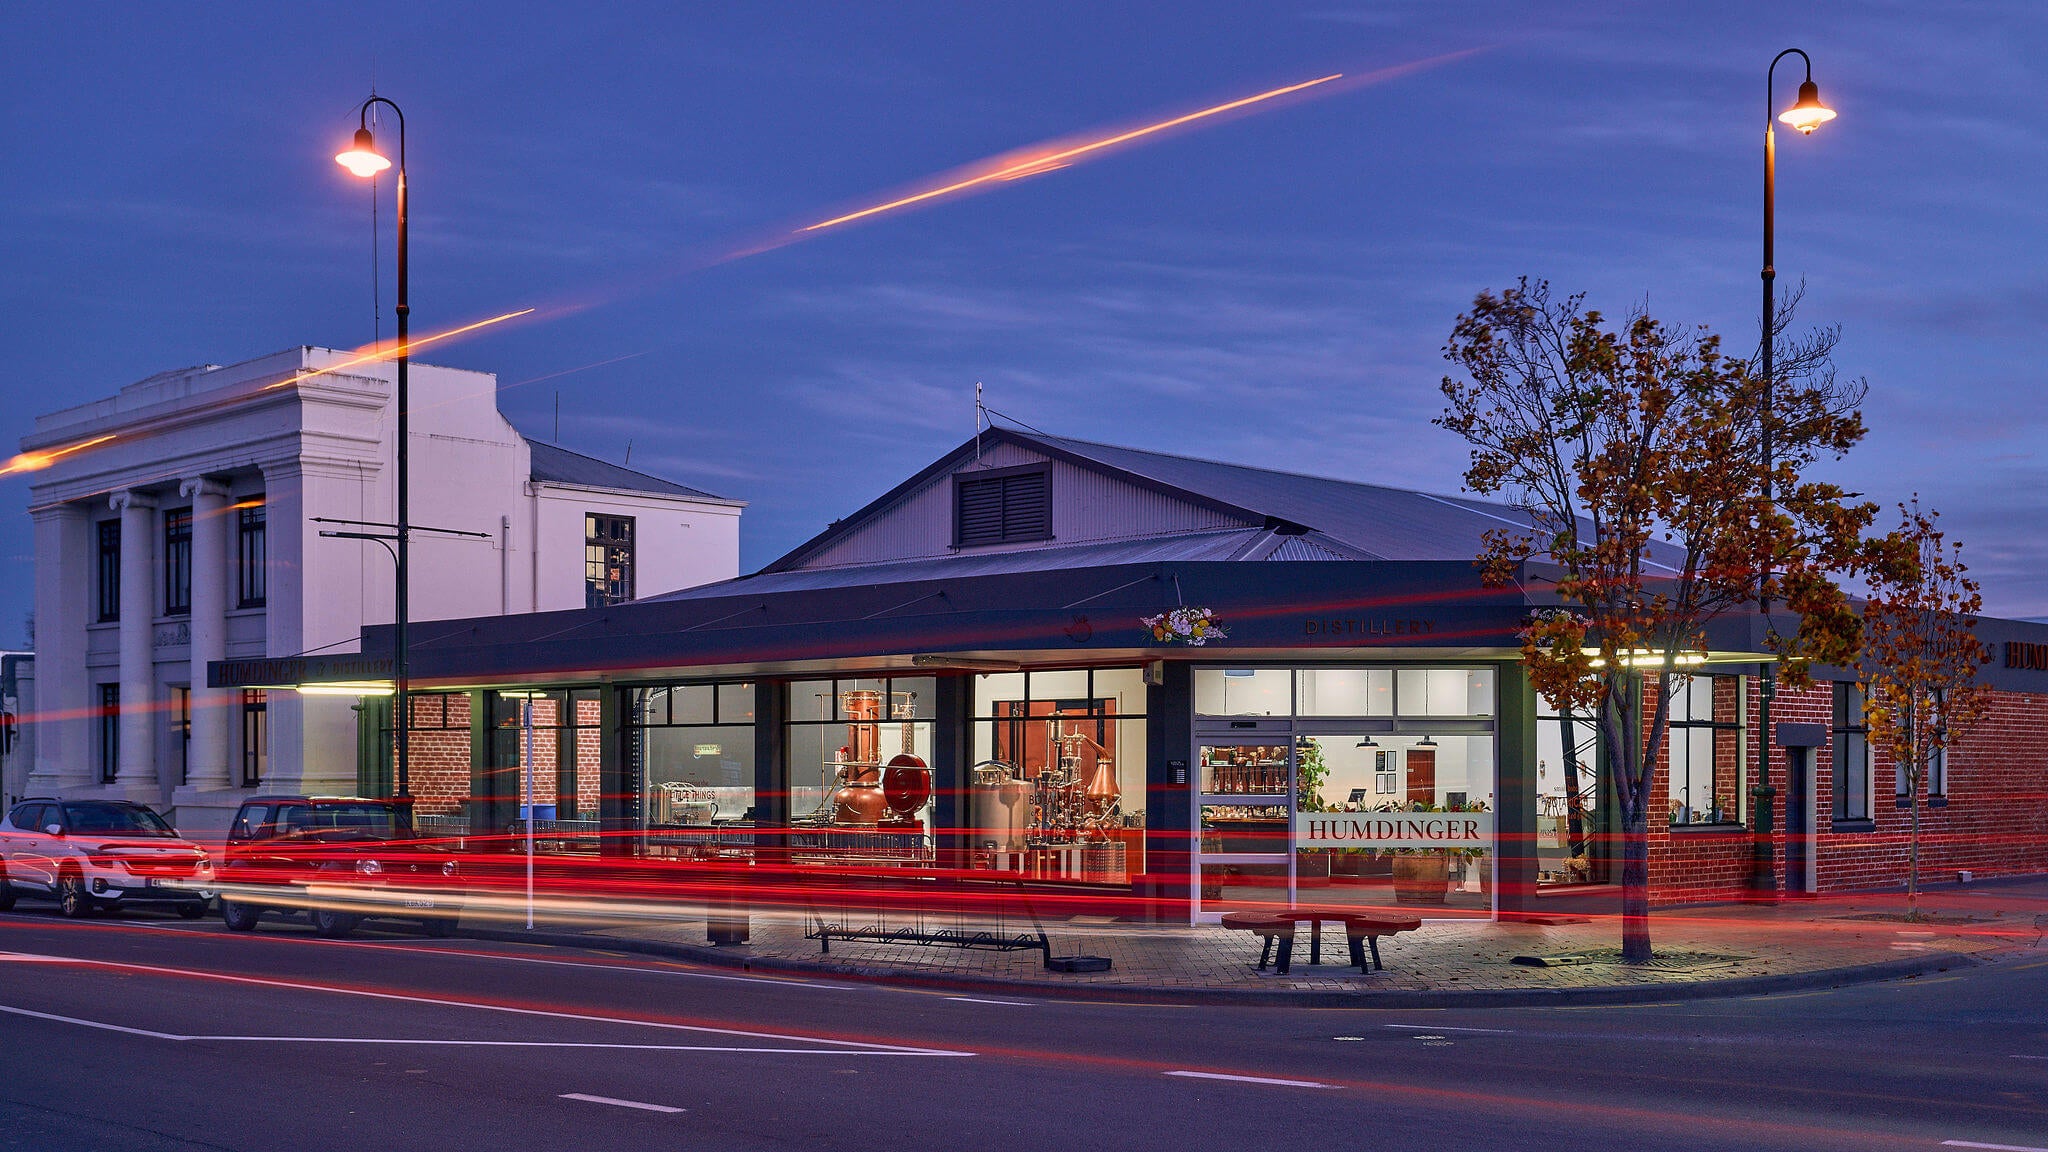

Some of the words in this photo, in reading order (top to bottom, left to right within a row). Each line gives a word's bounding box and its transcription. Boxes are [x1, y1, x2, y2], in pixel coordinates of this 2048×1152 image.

[1305, 618, 1436, 634] DISTILLERY
[218, 659, 308, 684] HUMDINGER
[332, 658, 393, 675] DISTILLERY
[692, 790, 716, 800] THINGS
[1308, 819, 1481, 841] HUMDINGER
